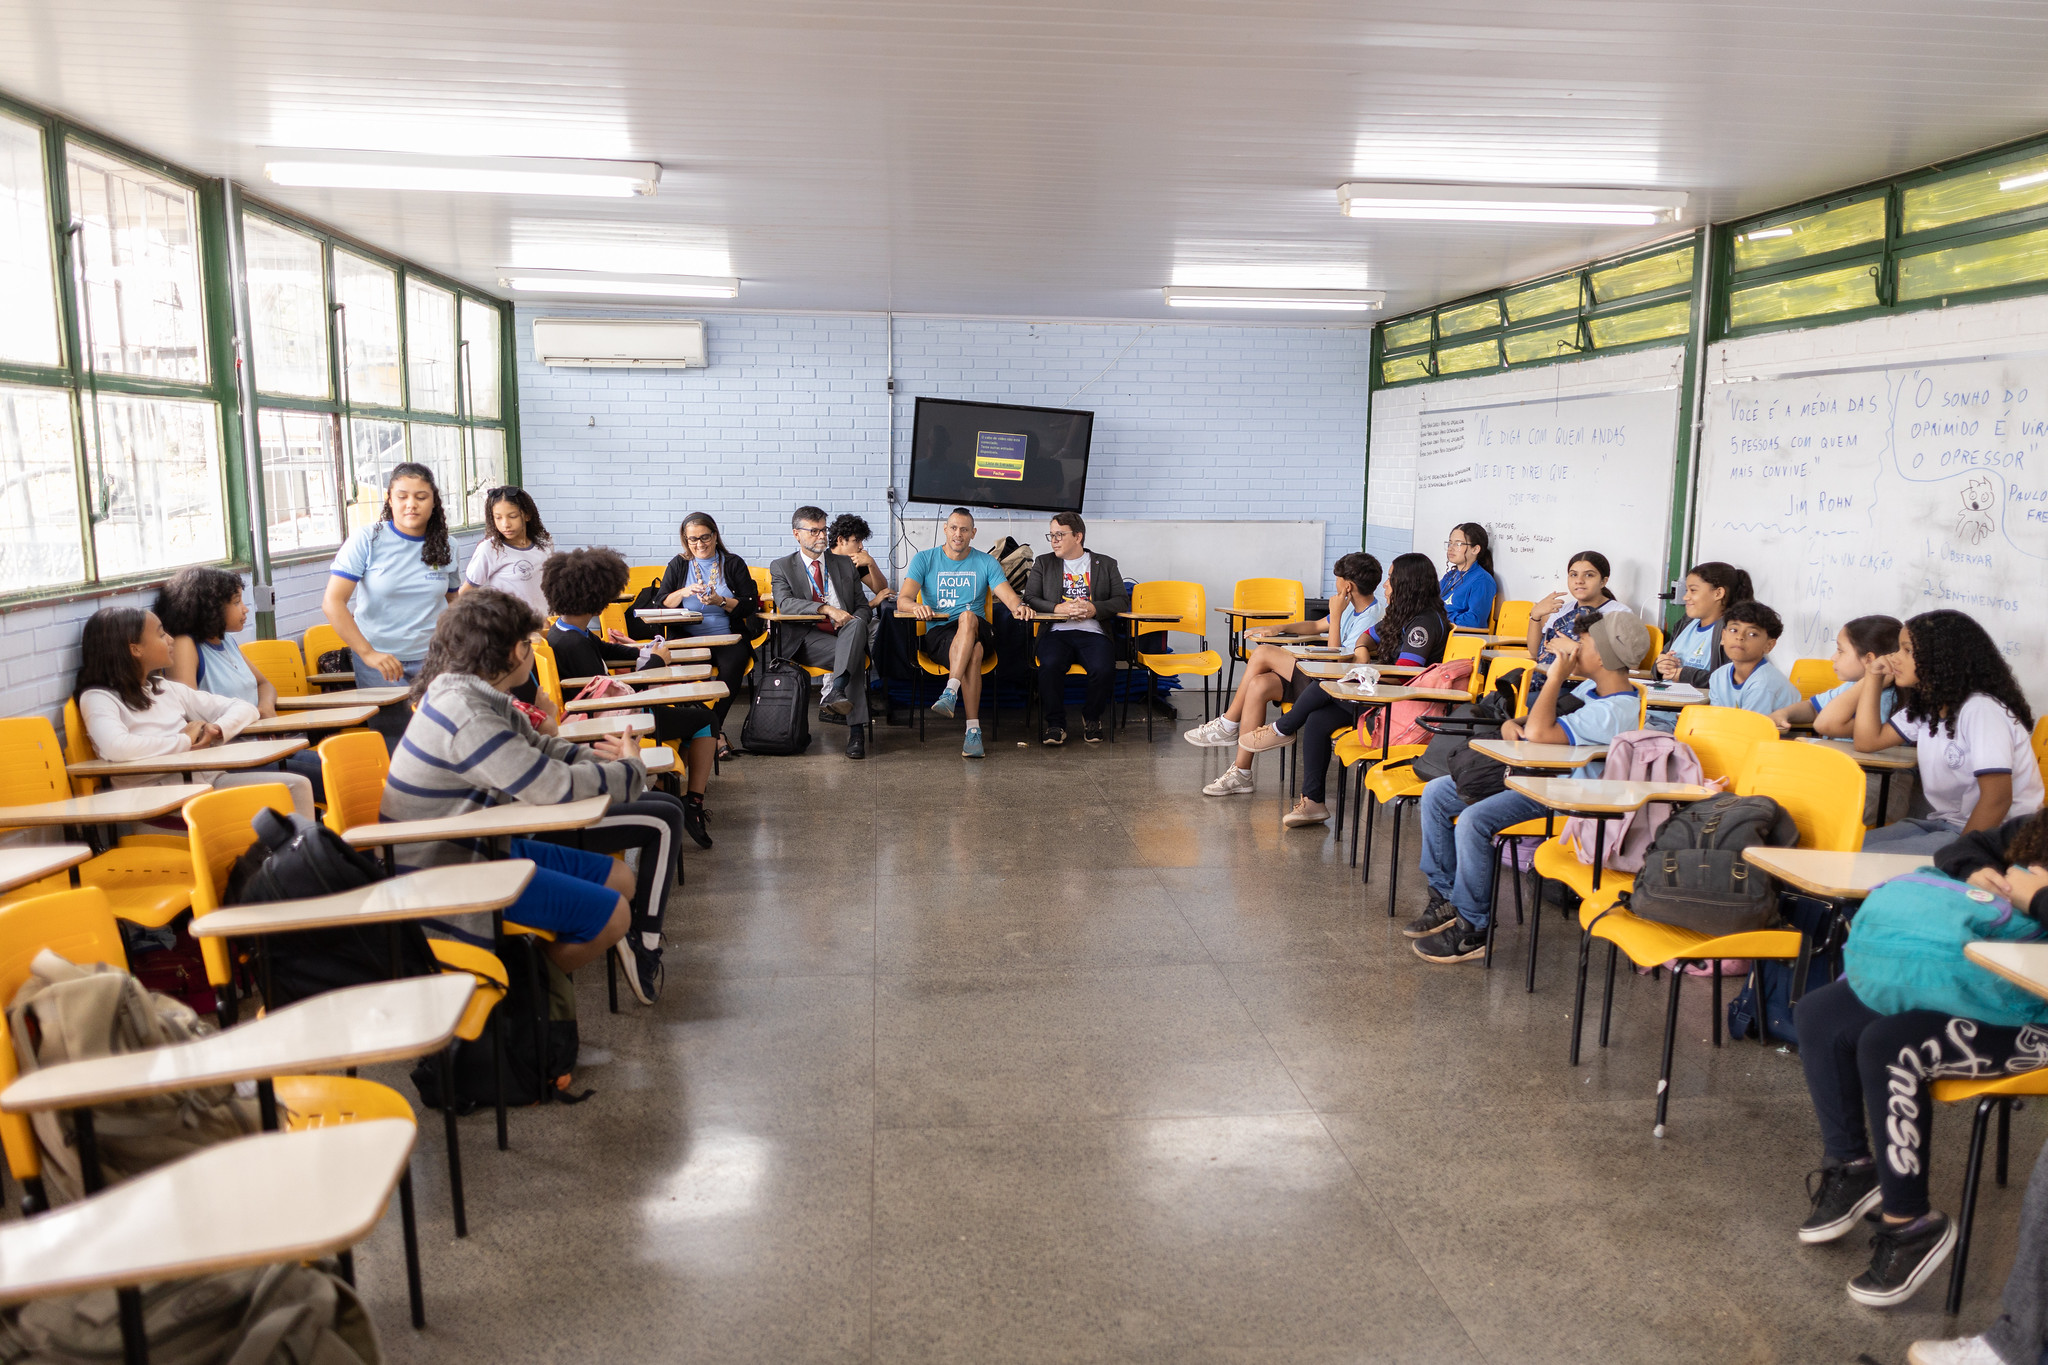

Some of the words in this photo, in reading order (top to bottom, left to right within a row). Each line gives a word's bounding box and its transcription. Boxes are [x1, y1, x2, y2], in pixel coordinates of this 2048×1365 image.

[1768, 399, 1780, 420] É
[1785, 404, 1791, 417] A
[1800, 392, 1837, 417] MÉDIA
[1847, 395, 1878, 414] DAS
[1941, 389, 1990, 407] SONHO
[2002, 388, 2028, 403] DO
[1911, 415, 1979, 439] OPRIMIDO
[1994, 409, 2011, 436] É
[1500, 428, 1520, 446] DIGA
[1528, 427, 1547, 445] COM
[1555, 426, 1584, 446] QUEM
[1591, 425, 1626, 447] ANDAS
[1791, 436, 1812, 448] COM
[1821, 434, 1858, 449] QUEM
[1912, 452, 1924, 469] O
[1492, 464, 1502, 478] EU
[1505, 465, 1516, 480] TE
[1522, 463, 1543, 480] DIREI
[1730, 464, 1753, 480] MAIS
[1819, 491, 1853, 512] ROHN
[2008, 484, 2048, 502] PAULO
[939, 577, 971, 587] AQUA
[939, 589, 960, 598] THL
[939, 598, 956, 608] ON
[1803, 609, 1838, 644] VIOL
